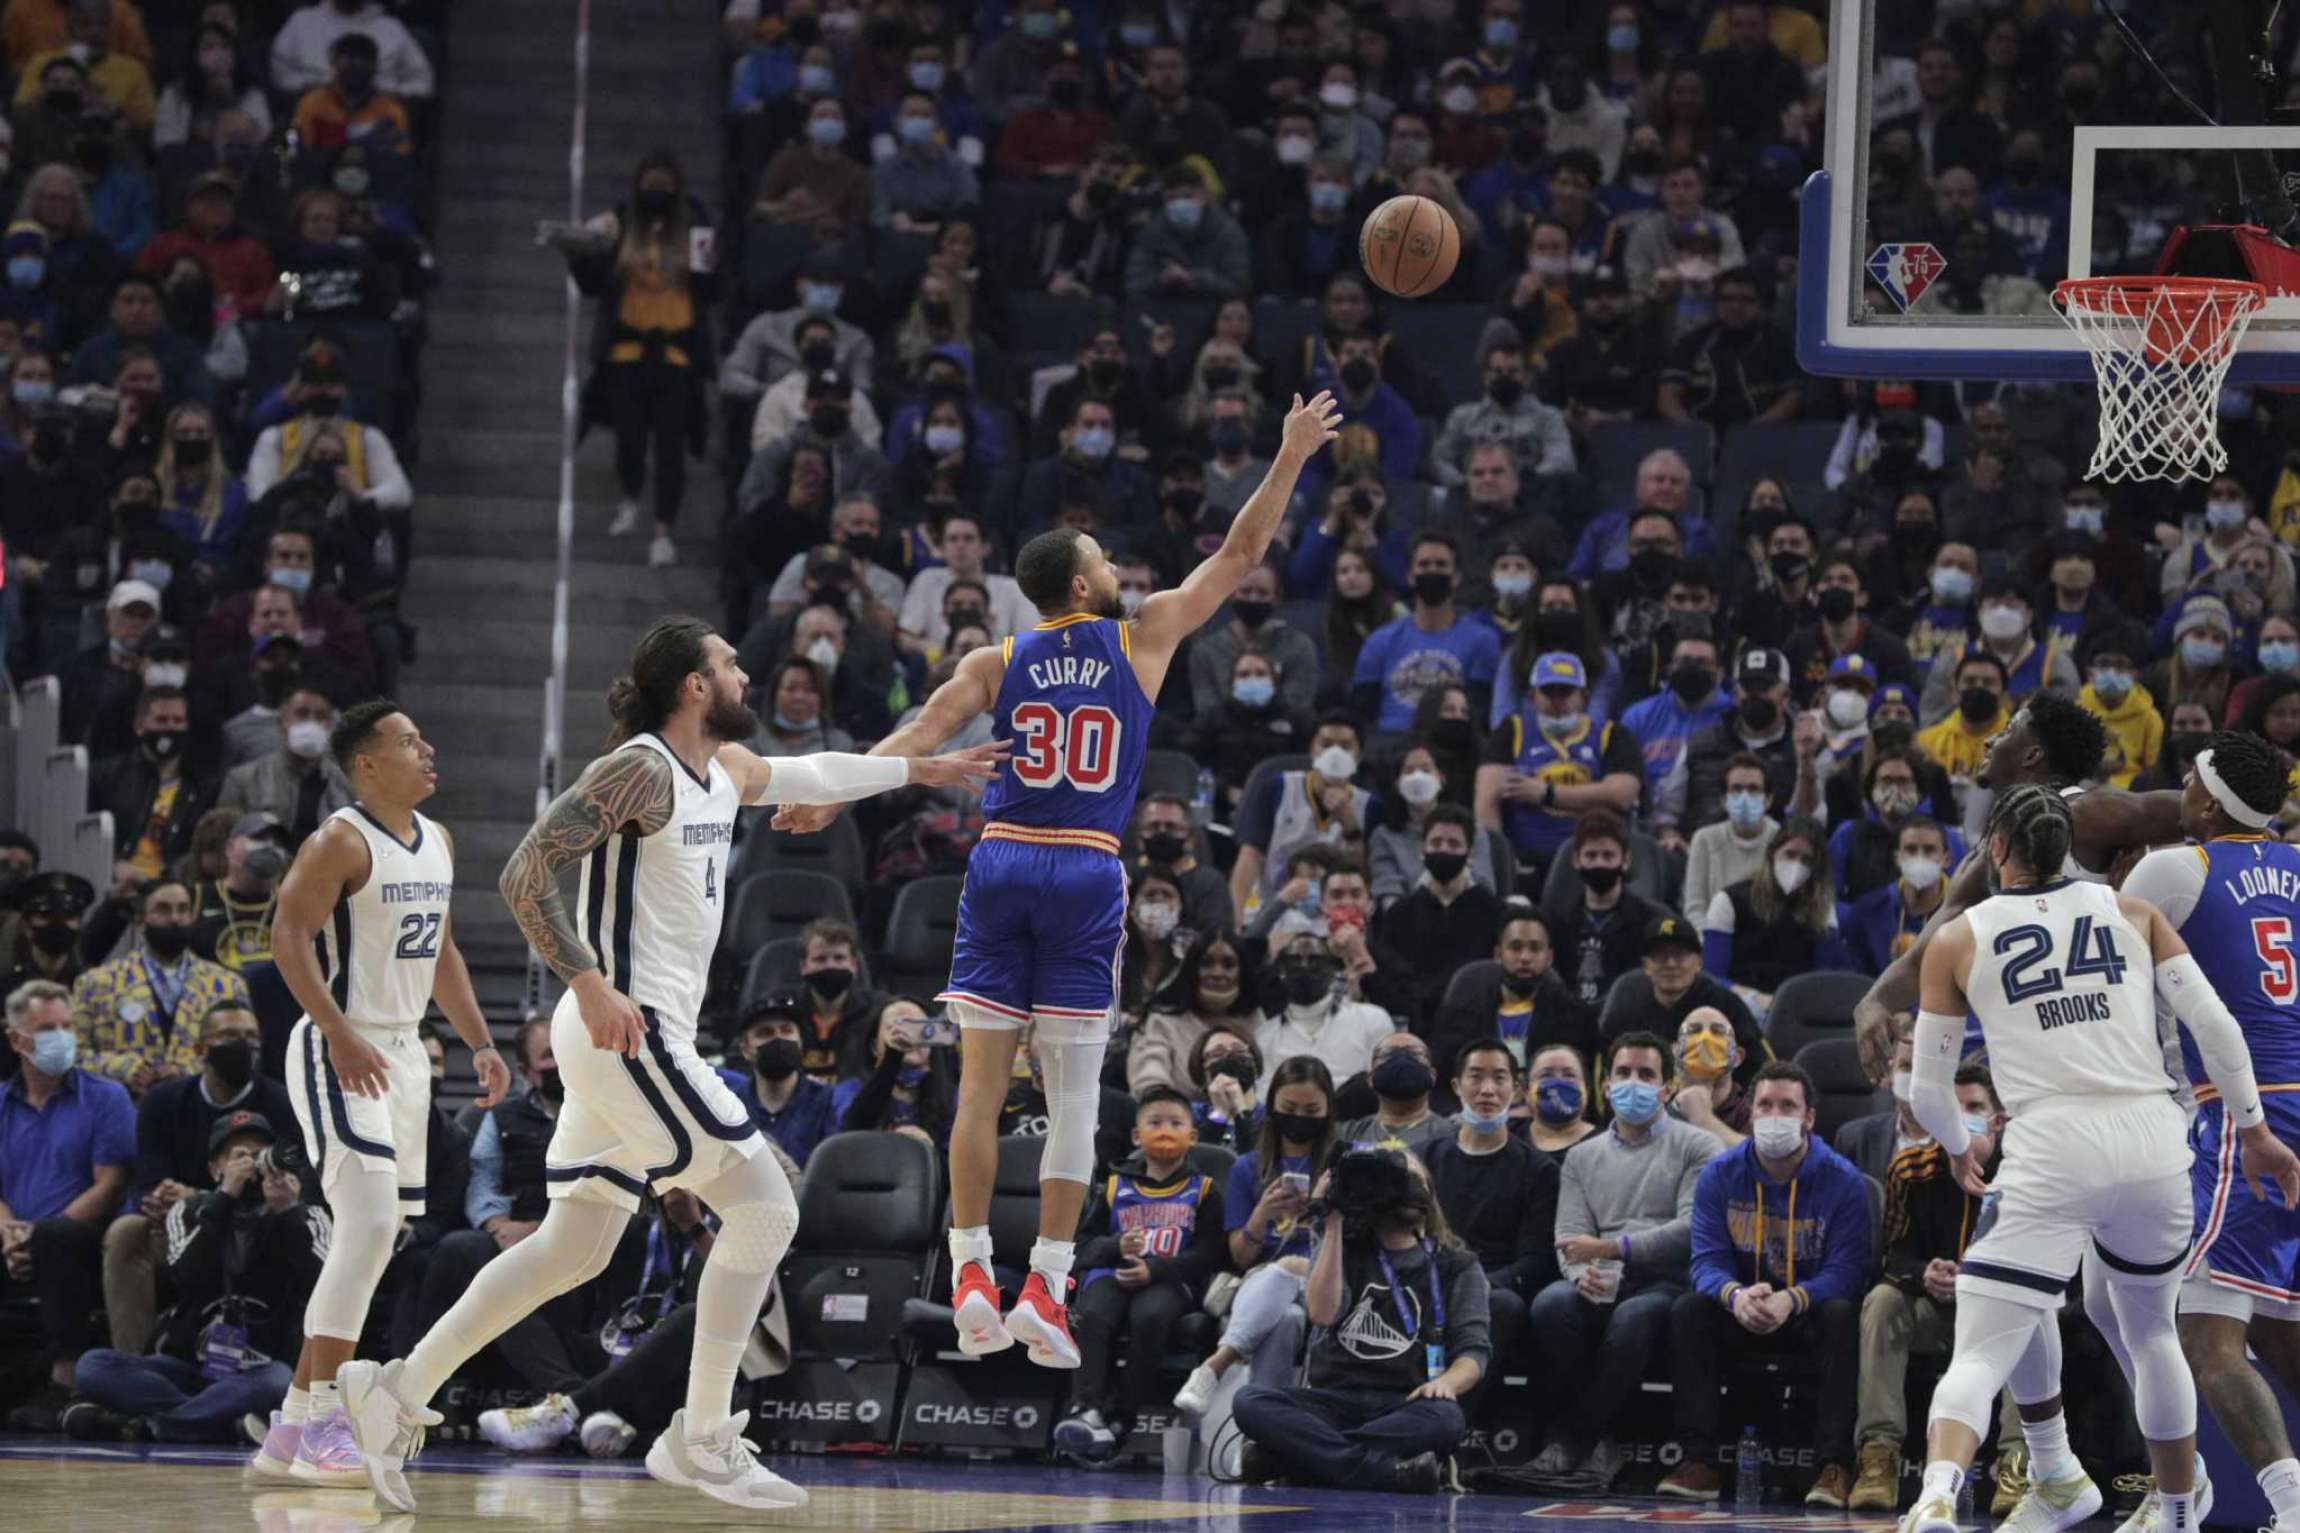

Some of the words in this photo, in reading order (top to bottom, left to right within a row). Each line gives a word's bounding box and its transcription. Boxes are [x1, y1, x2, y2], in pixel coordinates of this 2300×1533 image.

[1913, 253, 1929, 275] 75
[1028, 656, 1111, 690] CURRY
[1011, 701, 1122, 794] 30
[705, 857, 717, 906] 4
[2224, 866, 2300, 906] LOONEY
[396, 912, 442, 959] 22
[1993, 915, 2127, 1005] 24
[2251, 916, 2299, 1006] 5
[2035, 992, 2111, 1031] BROOKS
[759, 1400, 851, 1421] CHASE
[915, 1404, 1011, 1426] CHASE
